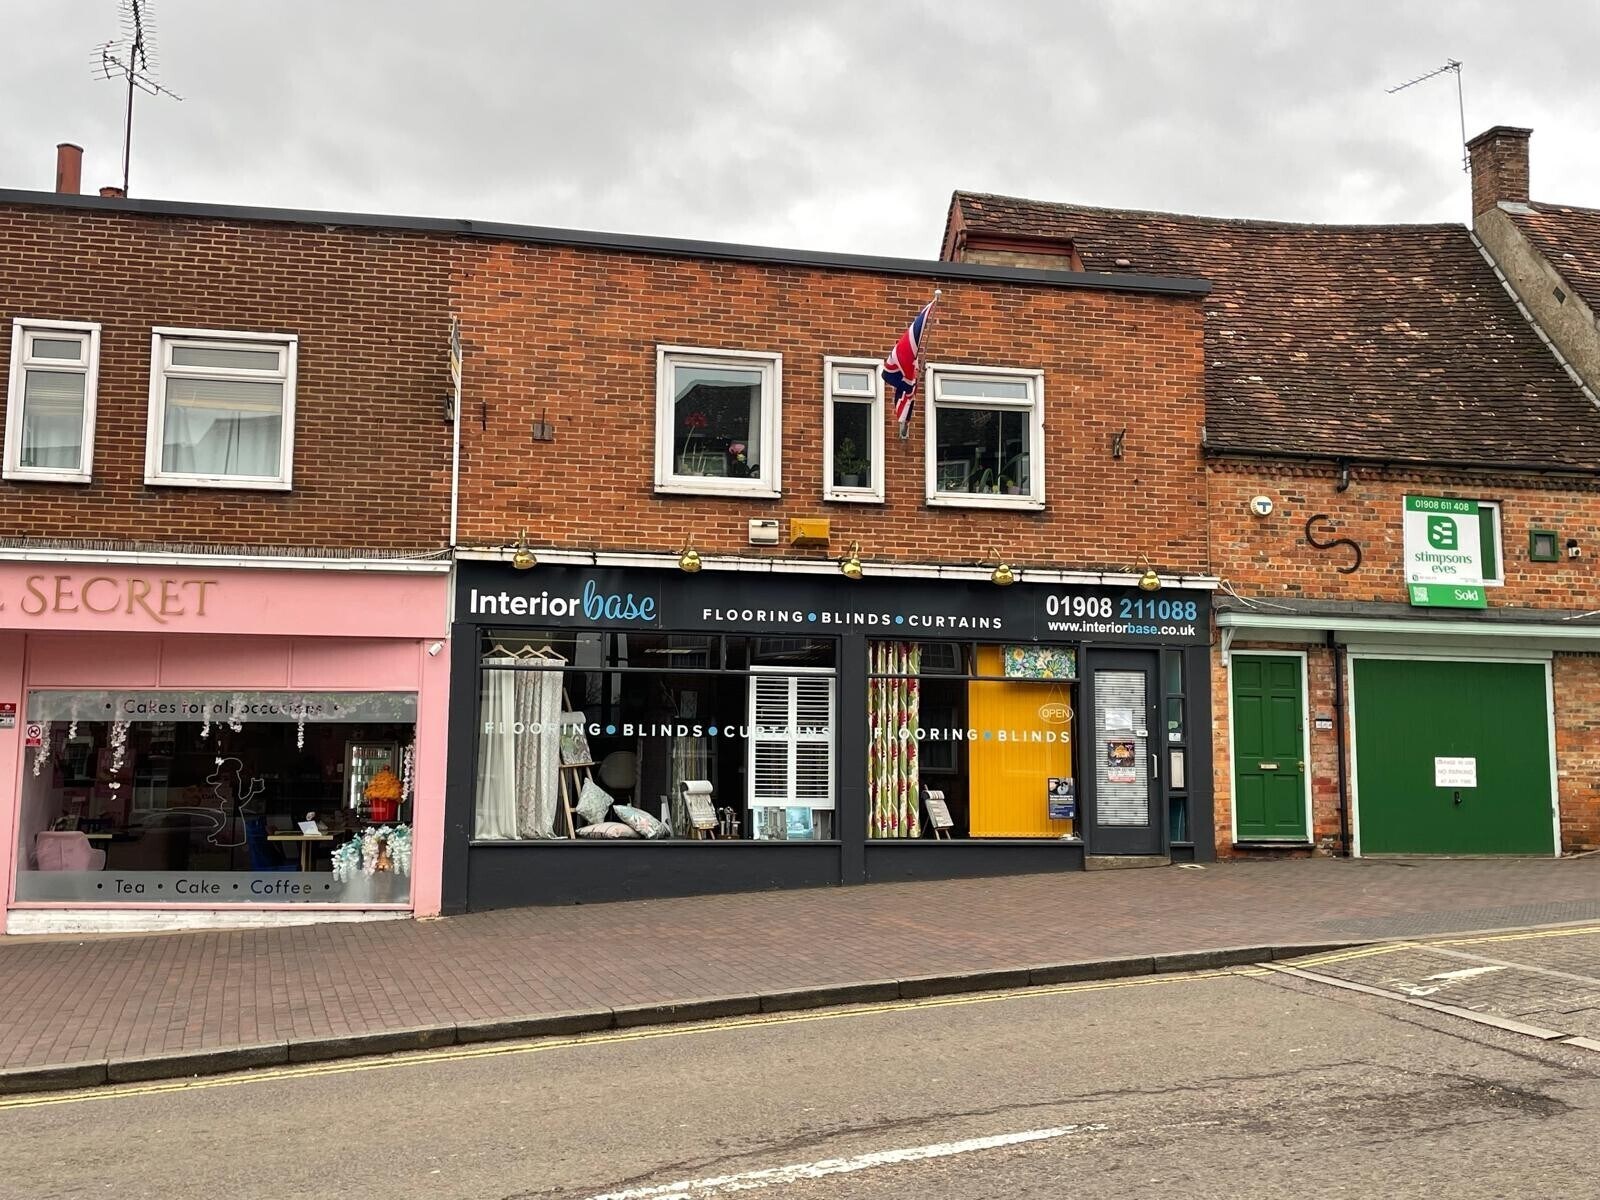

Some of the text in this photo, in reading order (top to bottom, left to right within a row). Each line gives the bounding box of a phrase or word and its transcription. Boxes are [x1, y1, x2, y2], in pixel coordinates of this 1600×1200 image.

[1415, 499, 1470, 511] 01908 611 408
[1414, 551, 1473, 565] stimpsons
[1431, 564, 1457, 575] eves
[20, 575, 219, 624] SECRET
[470, 579, 657, 621] Interior base
[1454, 588, 1479, 601] Sold
[1046, 595, 1198, 621] 01908 211088
[703, 609, 1003, 630] FLOORING BLINDS CURTAINS
[1047, 620, 1196, 637] www.interiorbase.co.uk
[123, 699, 176, 714] Cakes
[1042, 708, 1070, 719] OPEN
[485, 721, 600, 737] FLOOING
[623, 723, 703, 738] BLINDS
[873, 727, 1071, 743] FLOORING BLINDS
[115, 879, 312, 894] Tea Cake Coffee
